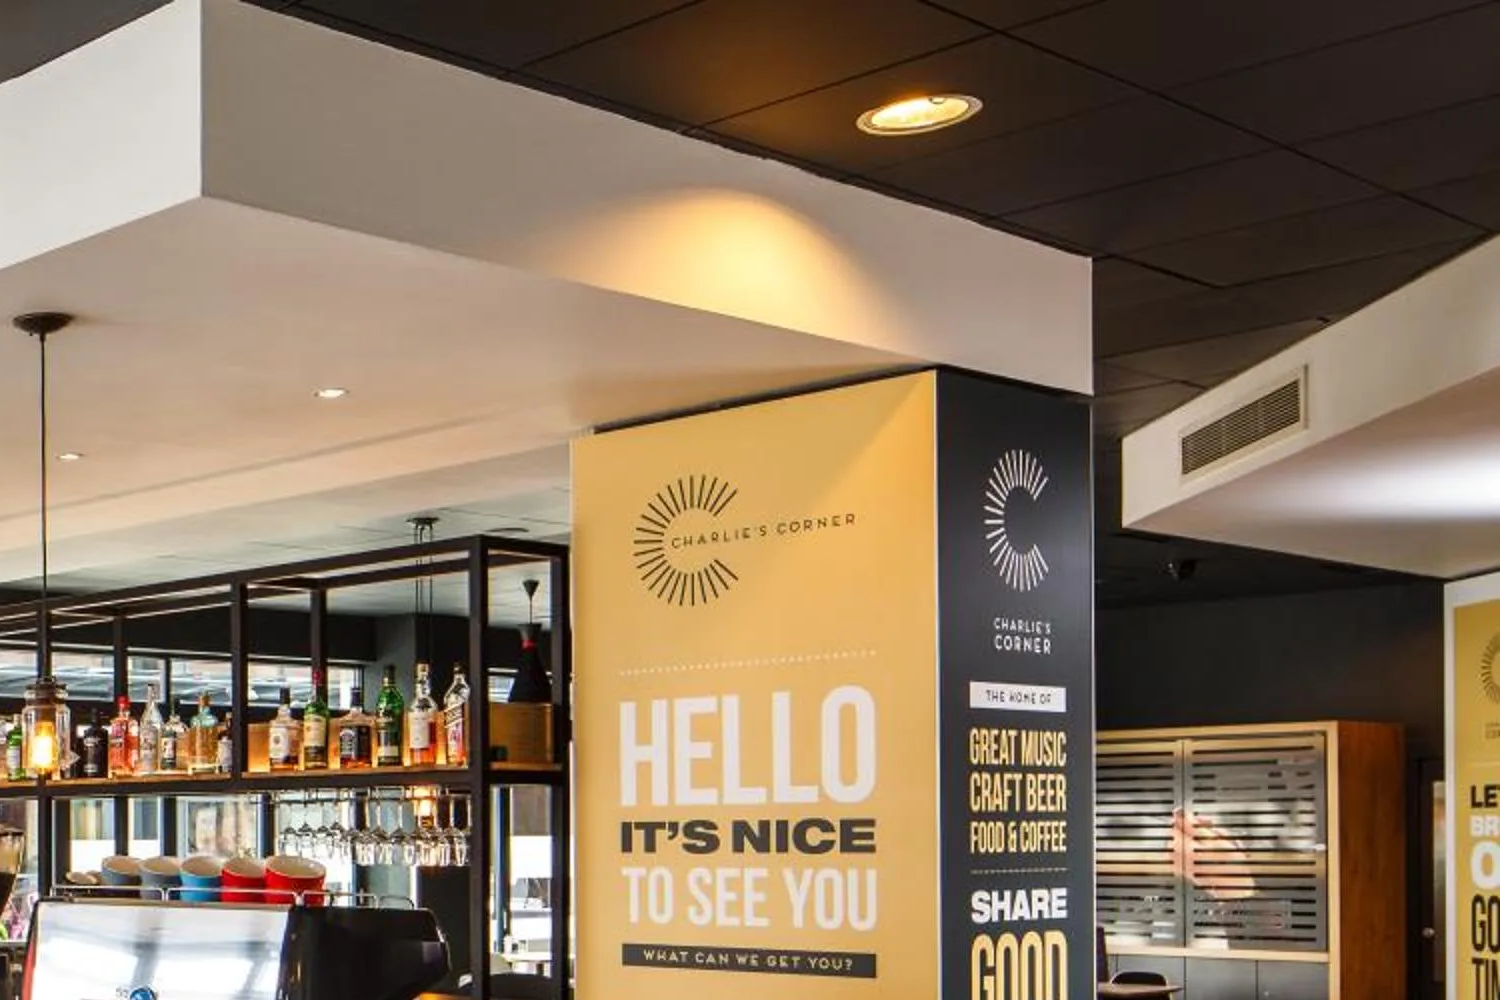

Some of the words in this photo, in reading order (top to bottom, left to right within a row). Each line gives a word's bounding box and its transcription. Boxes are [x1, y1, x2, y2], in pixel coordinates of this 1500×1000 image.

[671, 525, 768, 549] CHARLIE'S
[777, 513, 856, 536] CORNER
[992, 616, 1052, 635] CHARLIE'S
[993, 635, 1052, 655] CORNER
[986, 689, 1005, 703] THE
[1009, 690, 1037, 705] HOME
[1039, 692, 1052, 705] OF
[619, 685, 876, 807] HELLO
[969, 727, 1018, 766] GREAT
[1021, 728, 1068, 767] MUSIC
[969, 771, 1023, 813] CRAFT
[1025, 773, 1068, 813] BEER
[1470, 784, 1500, 809] LE
[620, 819, 721, 855] IT'S
[731, 817, 877, 855] NICE
[970, 821, 1005, 854] FOOD
[1007, 821, 1018, 853] &
[1019, 820, 1068, 853] COFFEE
[620, 865, 674, 925] TO
[687, 866, 771, 928] SEE
[781, 867, 878, 931] YOU
[970, 886, 1069, 925] SHARE
[642, 949, 688, 963] WHAT
[694, 951, 730, 966] CAN
[735, 953, 760, 967] WE
[766, 955, 801, 969] GET
[806, 957, 854, 971] YOU?
